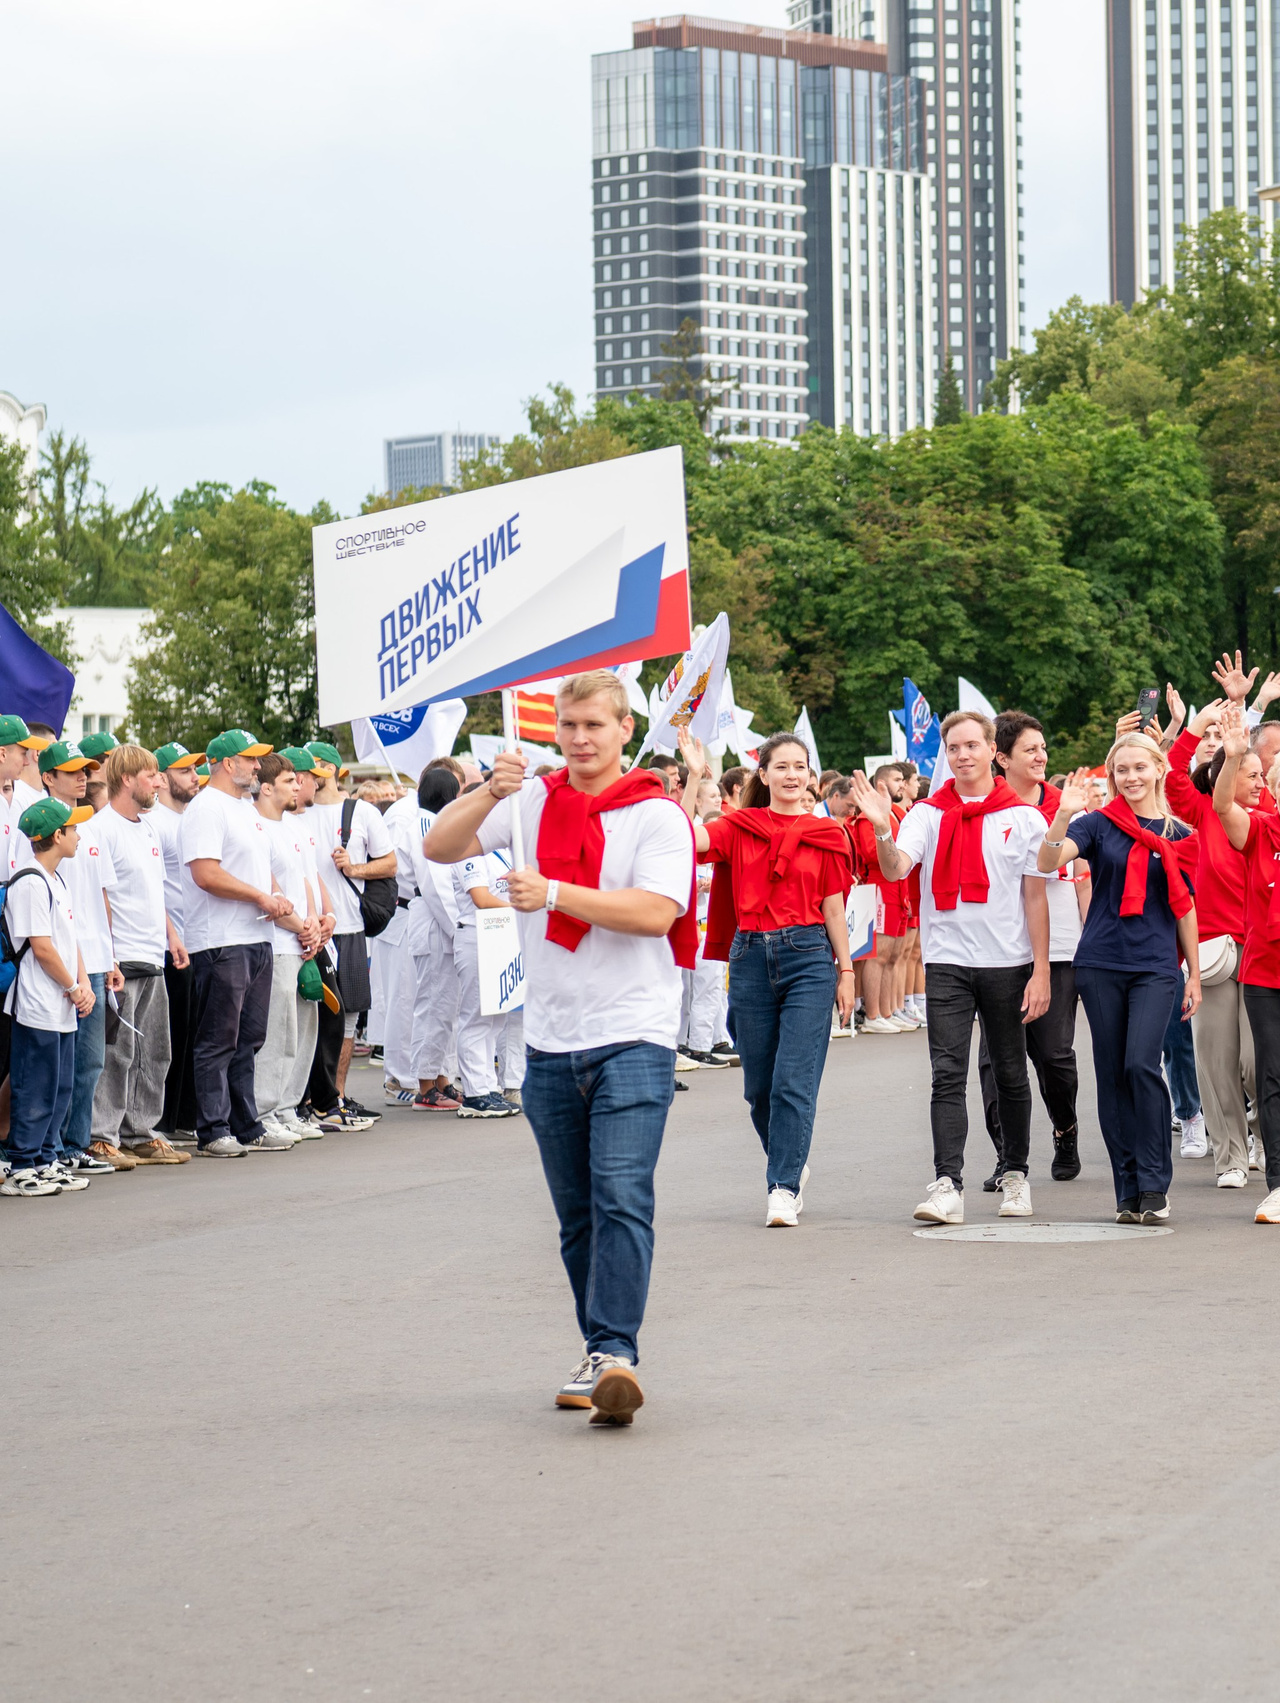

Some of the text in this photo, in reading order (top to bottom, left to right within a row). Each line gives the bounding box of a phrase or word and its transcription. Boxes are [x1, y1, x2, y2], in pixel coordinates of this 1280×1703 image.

[336, 538, 405, 560] ШЕСТВИЕ
[377, 511, 521, 663] ДВИЖЕНИЕ
[380, 587, 482, 701] ПЕРВЫХ
[379, 721, 400, 734] ВСЕХ
[498, 951, 525, 1010] ДЗЮ
